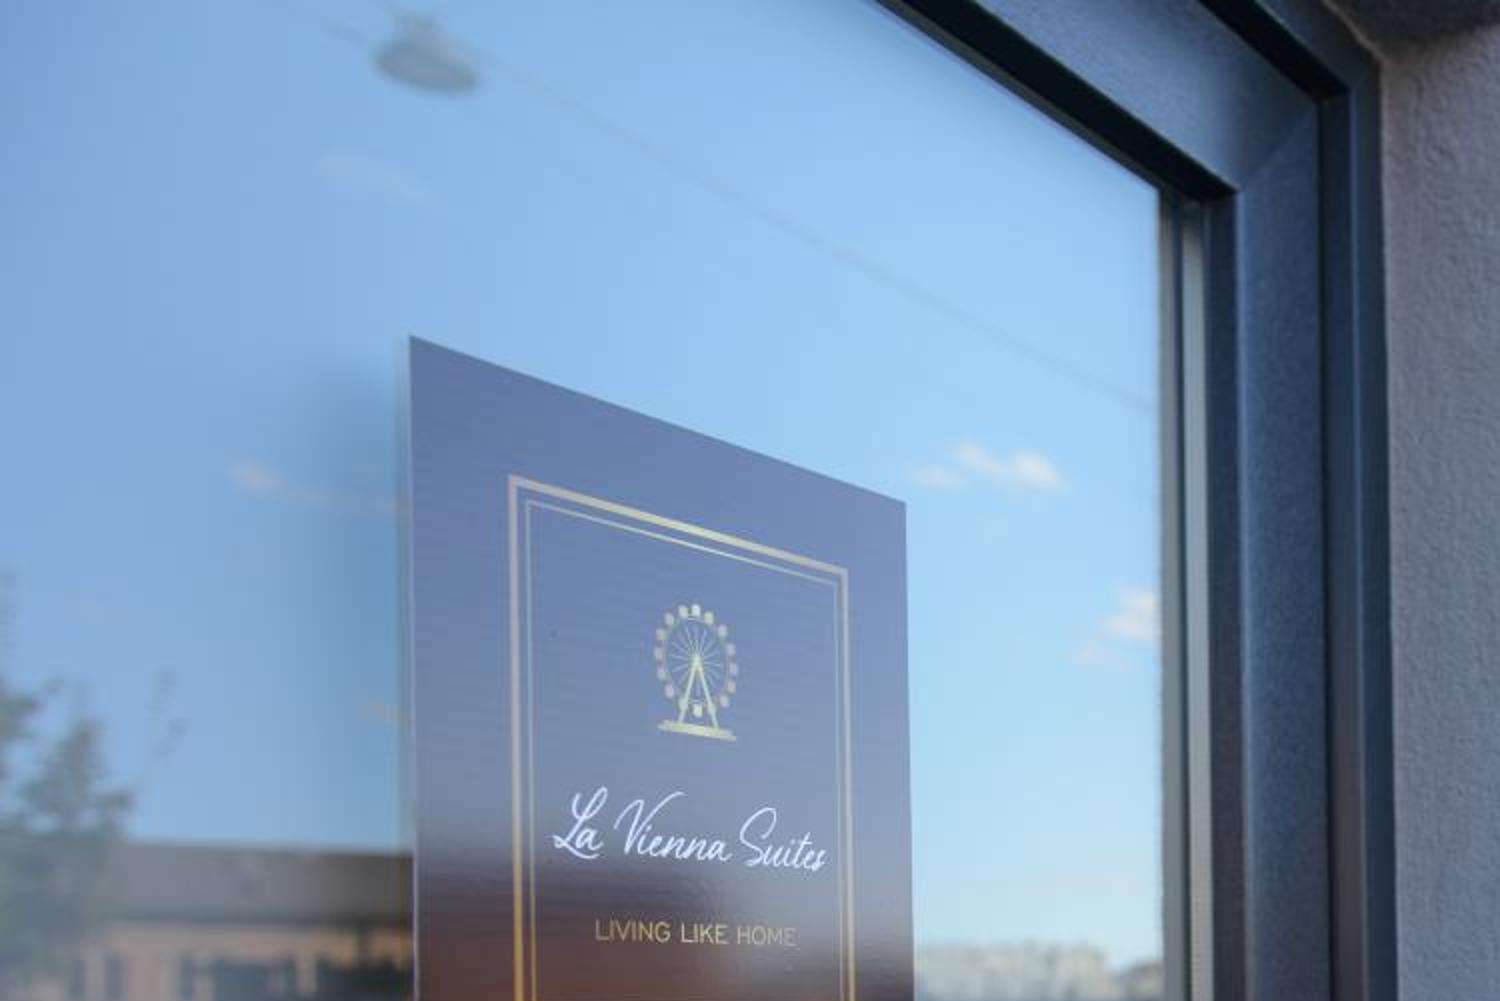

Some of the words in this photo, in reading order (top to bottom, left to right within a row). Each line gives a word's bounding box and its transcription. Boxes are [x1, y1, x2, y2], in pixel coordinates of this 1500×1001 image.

[552, 786, 608, 859] La
[613, 791, 733, 862] Vienna
[739, 806, 827, 872] Suites
[594, 918, 671, 944] LIVING
[680, 922, 729, 945] LIKE
[736, 924, 797, 947] HOME
